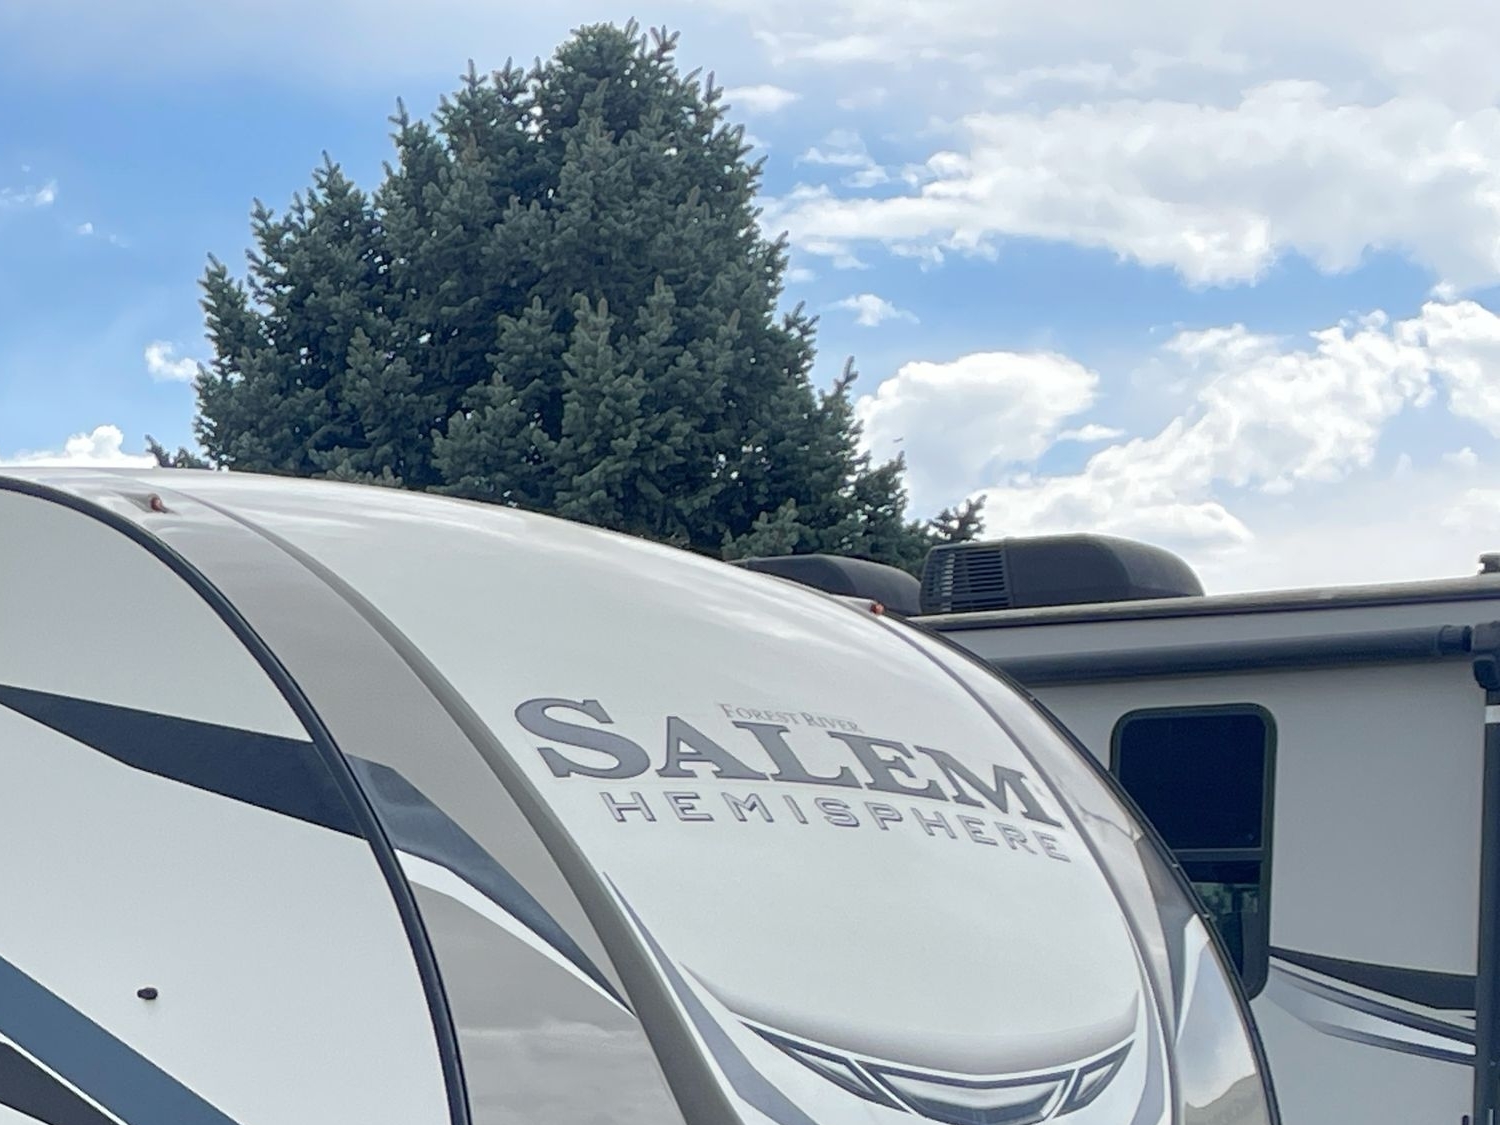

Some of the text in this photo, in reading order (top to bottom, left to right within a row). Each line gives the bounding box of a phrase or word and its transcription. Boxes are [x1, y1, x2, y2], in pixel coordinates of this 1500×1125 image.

[719, 703, 865, 734] FOREST RIVER
[514, 697, 1063, 829] SALEM
[598, 791, 1072, 863] HEMISPHERE
